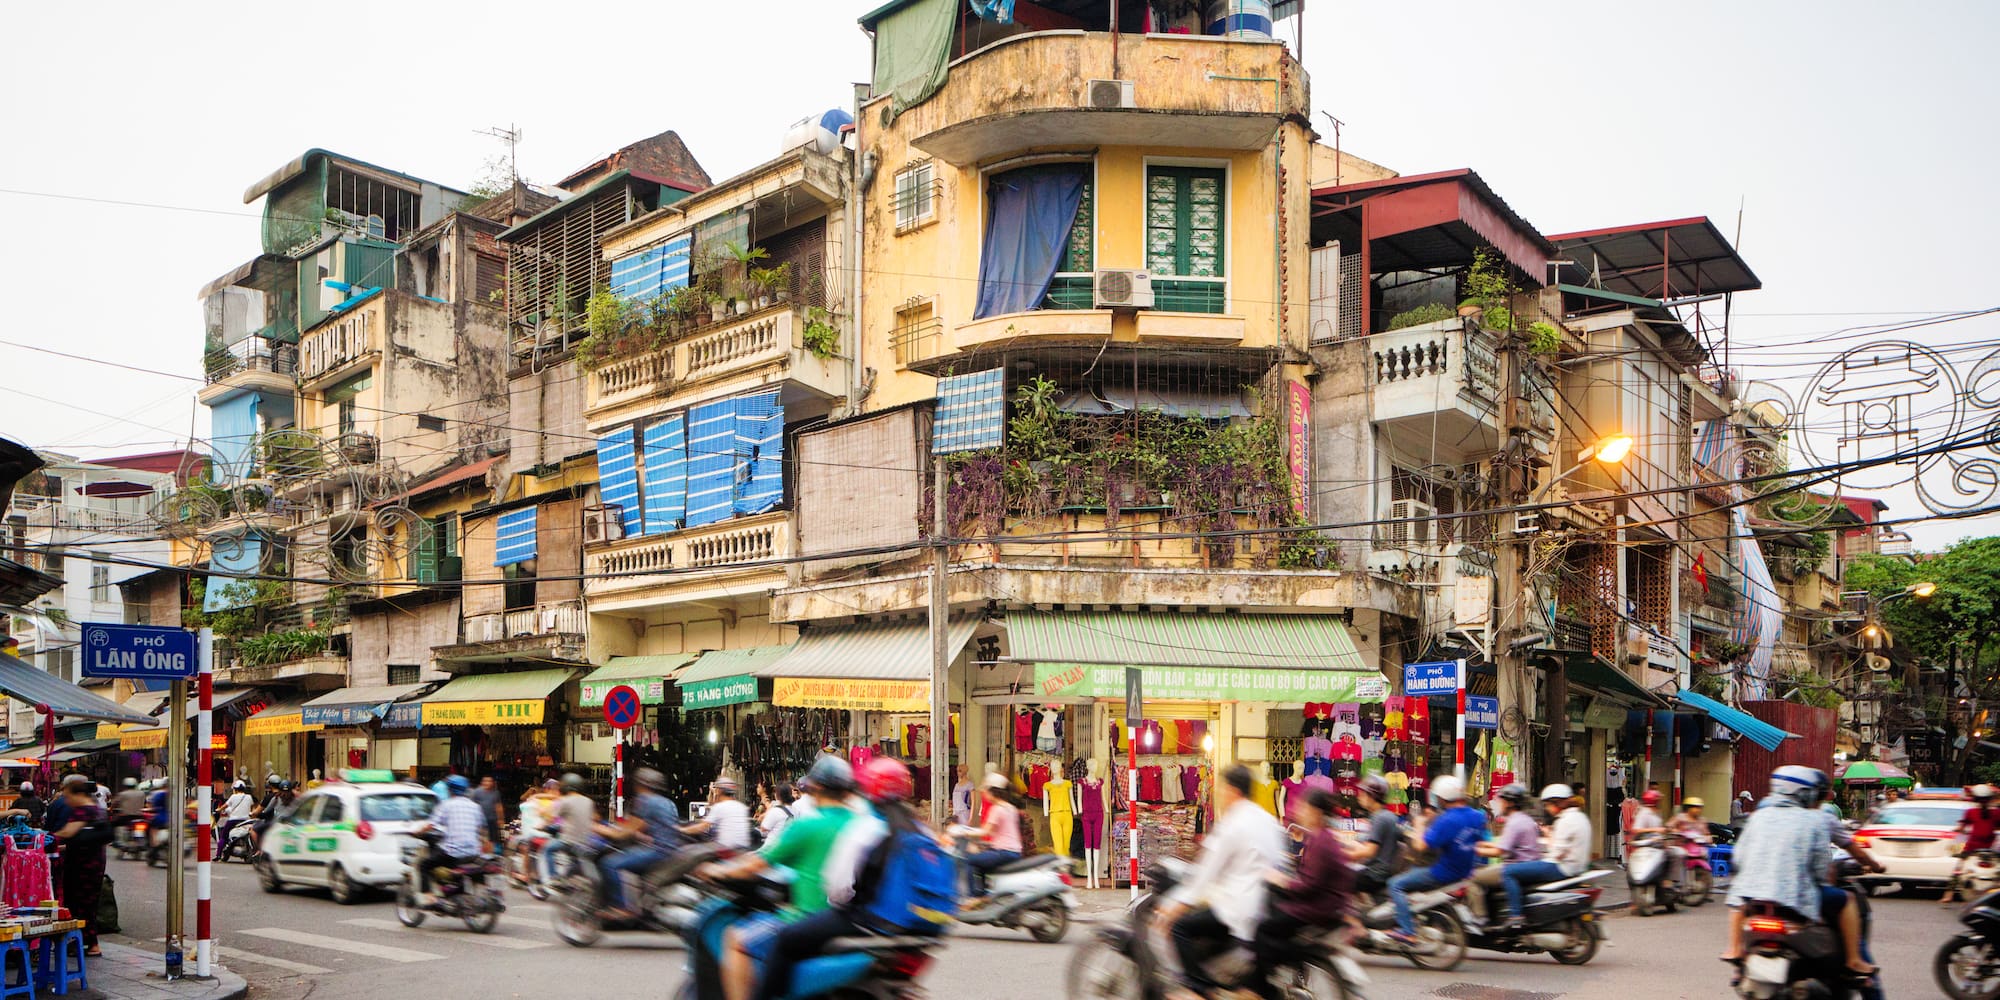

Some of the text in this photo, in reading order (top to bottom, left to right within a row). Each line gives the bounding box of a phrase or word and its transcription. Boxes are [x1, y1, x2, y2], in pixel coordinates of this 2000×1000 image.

[1291, 391, 1302, 426] BÓP
[1294, 432, 1302, 469] XOA
[133, 635, 165, 646] PHỐ
[95, 648, 185, 670] LÃN ÔNG
[1042, 664, 1085, 696] LIÊN LAN
[1094, 669, 1126, 685] CHUYÊ
[1142, 671, 1162, 685] UÔN
[1308, 675, 1327, 690] CAO
[1427, 666, 1443, 675] PHỐ
[1407, 677, 1428, 690] HÀNG
[682, 691, 694, 703] 75
[697, 687, 721, 702] HÀNG
